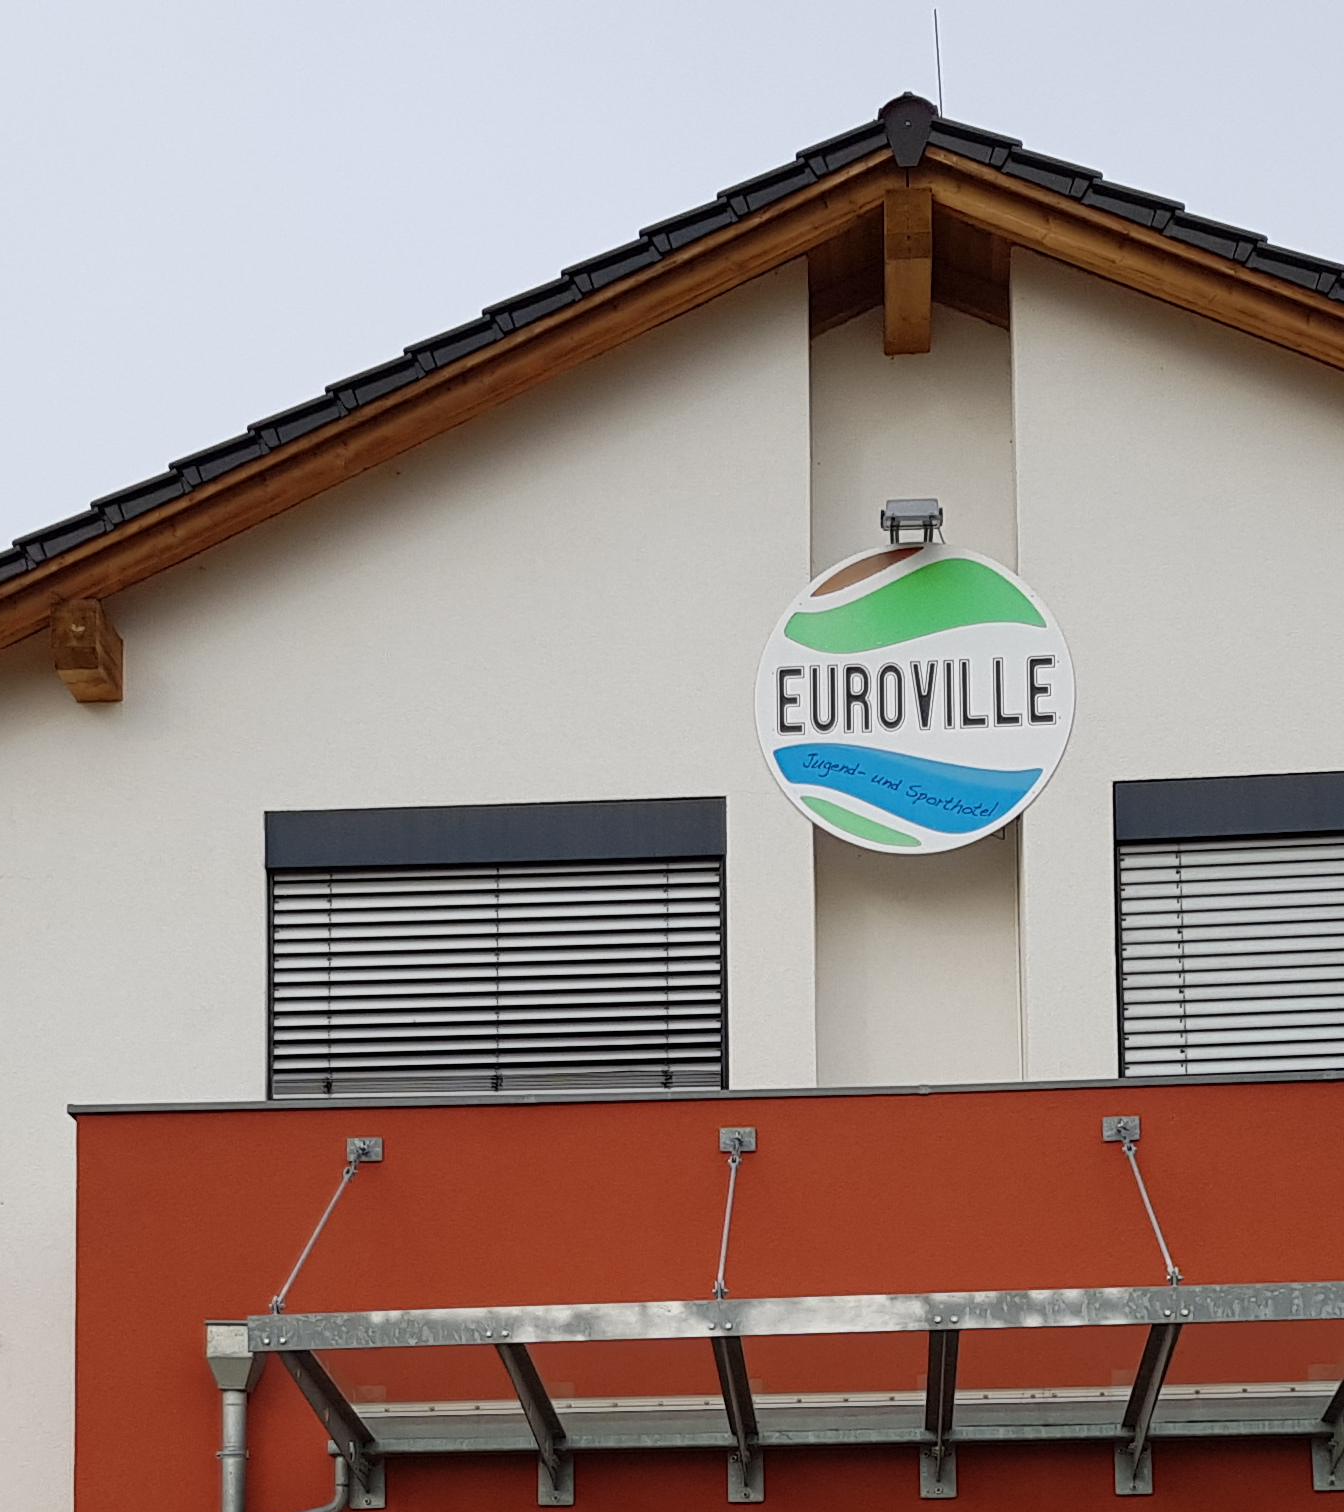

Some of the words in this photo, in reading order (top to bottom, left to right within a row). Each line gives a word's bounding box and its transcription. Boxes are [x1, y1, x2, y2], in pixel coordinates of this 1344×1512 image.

[776, 654, 1057, 736] EUROVILLE
[802, 752, 867, 778] Jugend-
[870, 772, 903, 792] und
[905, 784, 998, 819] Sporthotel
